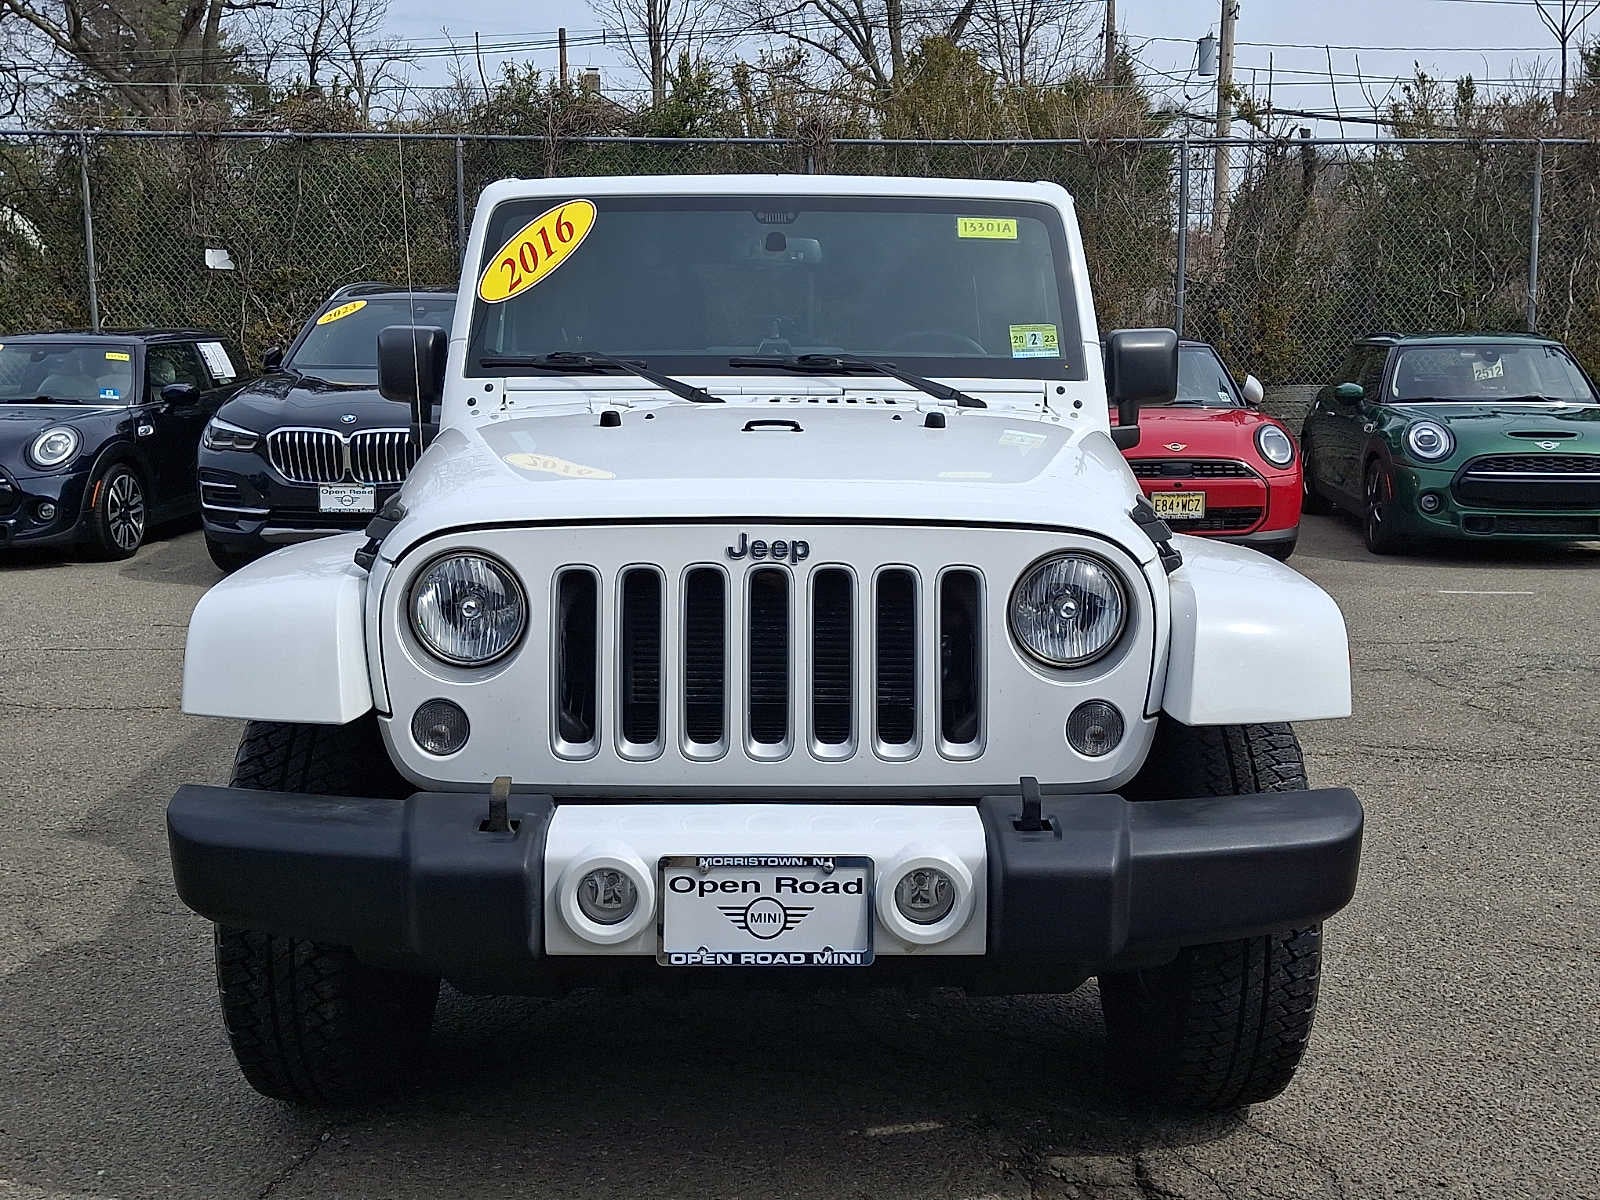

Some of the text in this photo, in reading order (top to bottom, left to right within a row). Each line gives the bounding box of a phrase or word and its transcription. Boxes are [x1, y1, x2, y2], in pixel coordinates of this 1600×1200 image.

[963, 221, 1012, 233] 13301A
[500, 208, 574, 293] 2016
[1013, 335, 1024, 344] 20
[1030, 333, 1038, 346] 2
[727, 532, 810, 565] Jeep
[669, 876, 863, 897] Open Road
[750, 913, 781, 924] MINI
[670, 952, 861, 964] OPEN ROAD MINI
